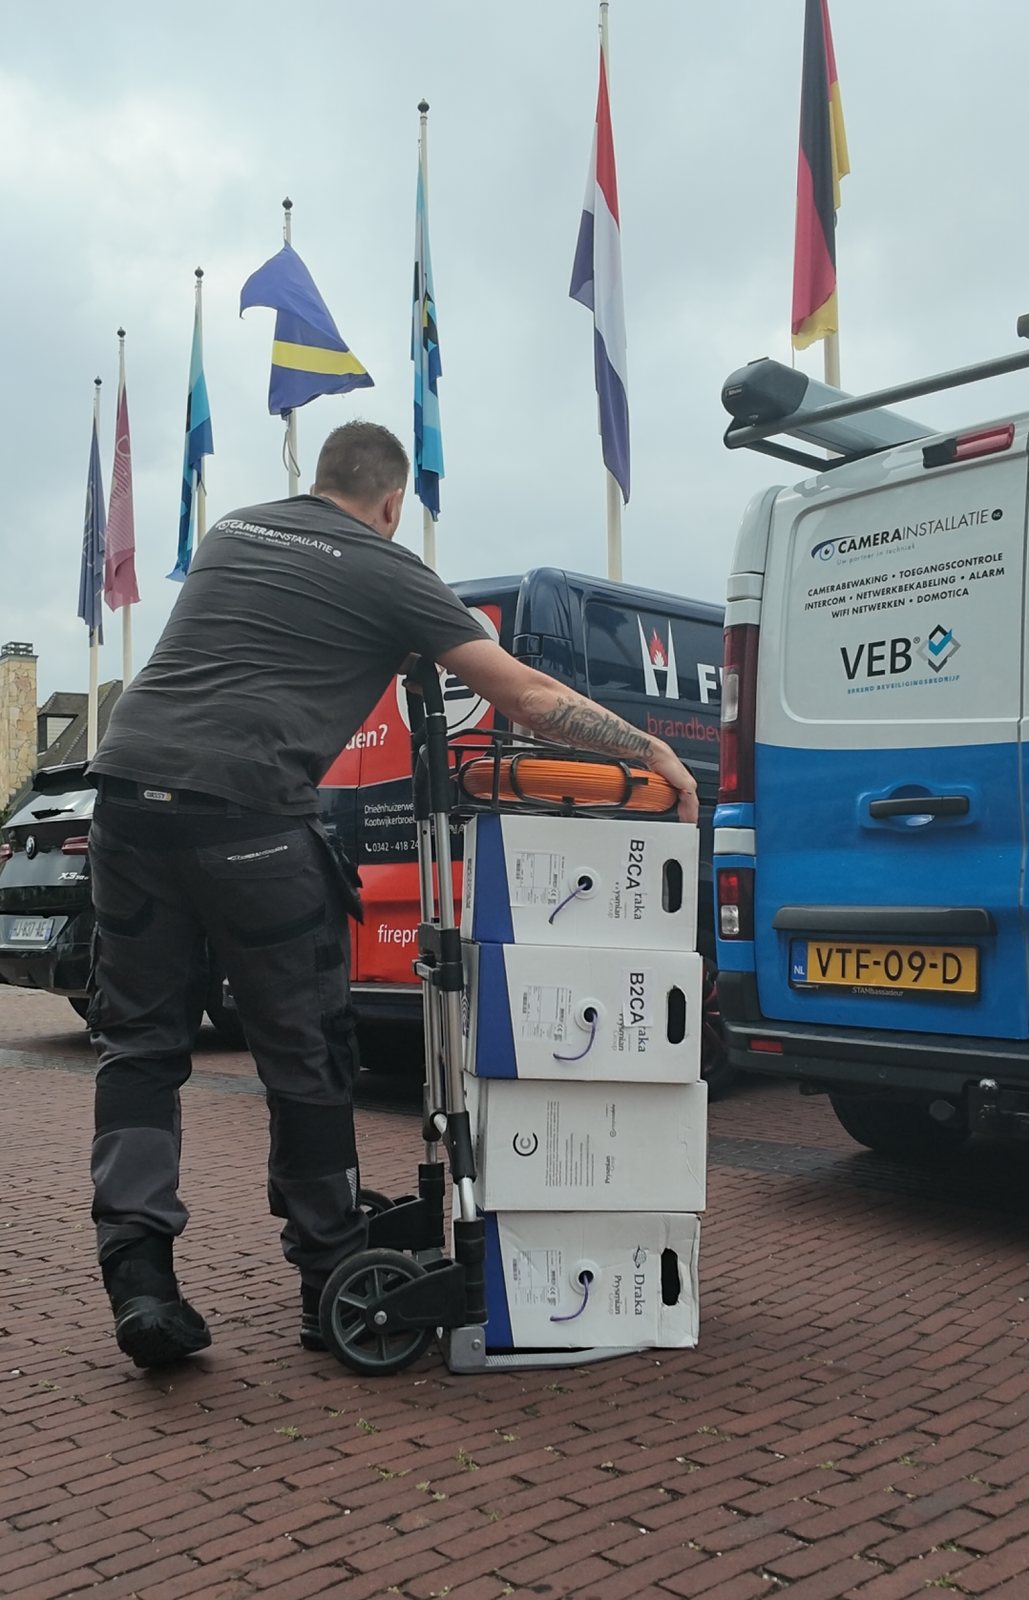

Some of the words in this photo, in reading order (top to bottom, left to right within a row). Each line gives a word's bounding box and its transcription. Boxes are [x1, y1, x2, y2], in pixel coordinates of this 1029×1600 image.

[229, 521, 333, 554] CAMERAINSTALLATIE
[838, 509, 989, 554] CAMERAINSTALLATIE
[804, 595, 846, 611] INTERCOM
[856, 575, 957, 601] NETWERKBEKABELING
[969, 567, 1005, 581] ALARM
[807, 573, 888, 597] CAMERABEWAKING
[899, 552, 1004, 579] TOEGANGSCONTROLE
[831, 608, 850, 619] WIFI
[851, 598, 906, 616] NETWERKEN
[916, 587, 969, 604] DOMOTICA
[696, 662, 724, 704] F
[876, 674, 961, 691] BEVEILIGINGSBEDRIJF
[364, 803, 414, 815] Drieënhuizerwe
[372, 842, 389, 852] 0342
[395, 841, 408, 851] 418
[411, 840, 419, 850] 24
[625, 838, 645, 890] B2CA
[633, 890, 642, 920] raka
[793, 965, 806, 976] NL
[816, 947, 963, 985] VTF-09-D
[629, 972, 645, 1025] B2CA
[612, 1275, 622, 1315] Prysmian
[634, 1273, 645, 1316] Draka
